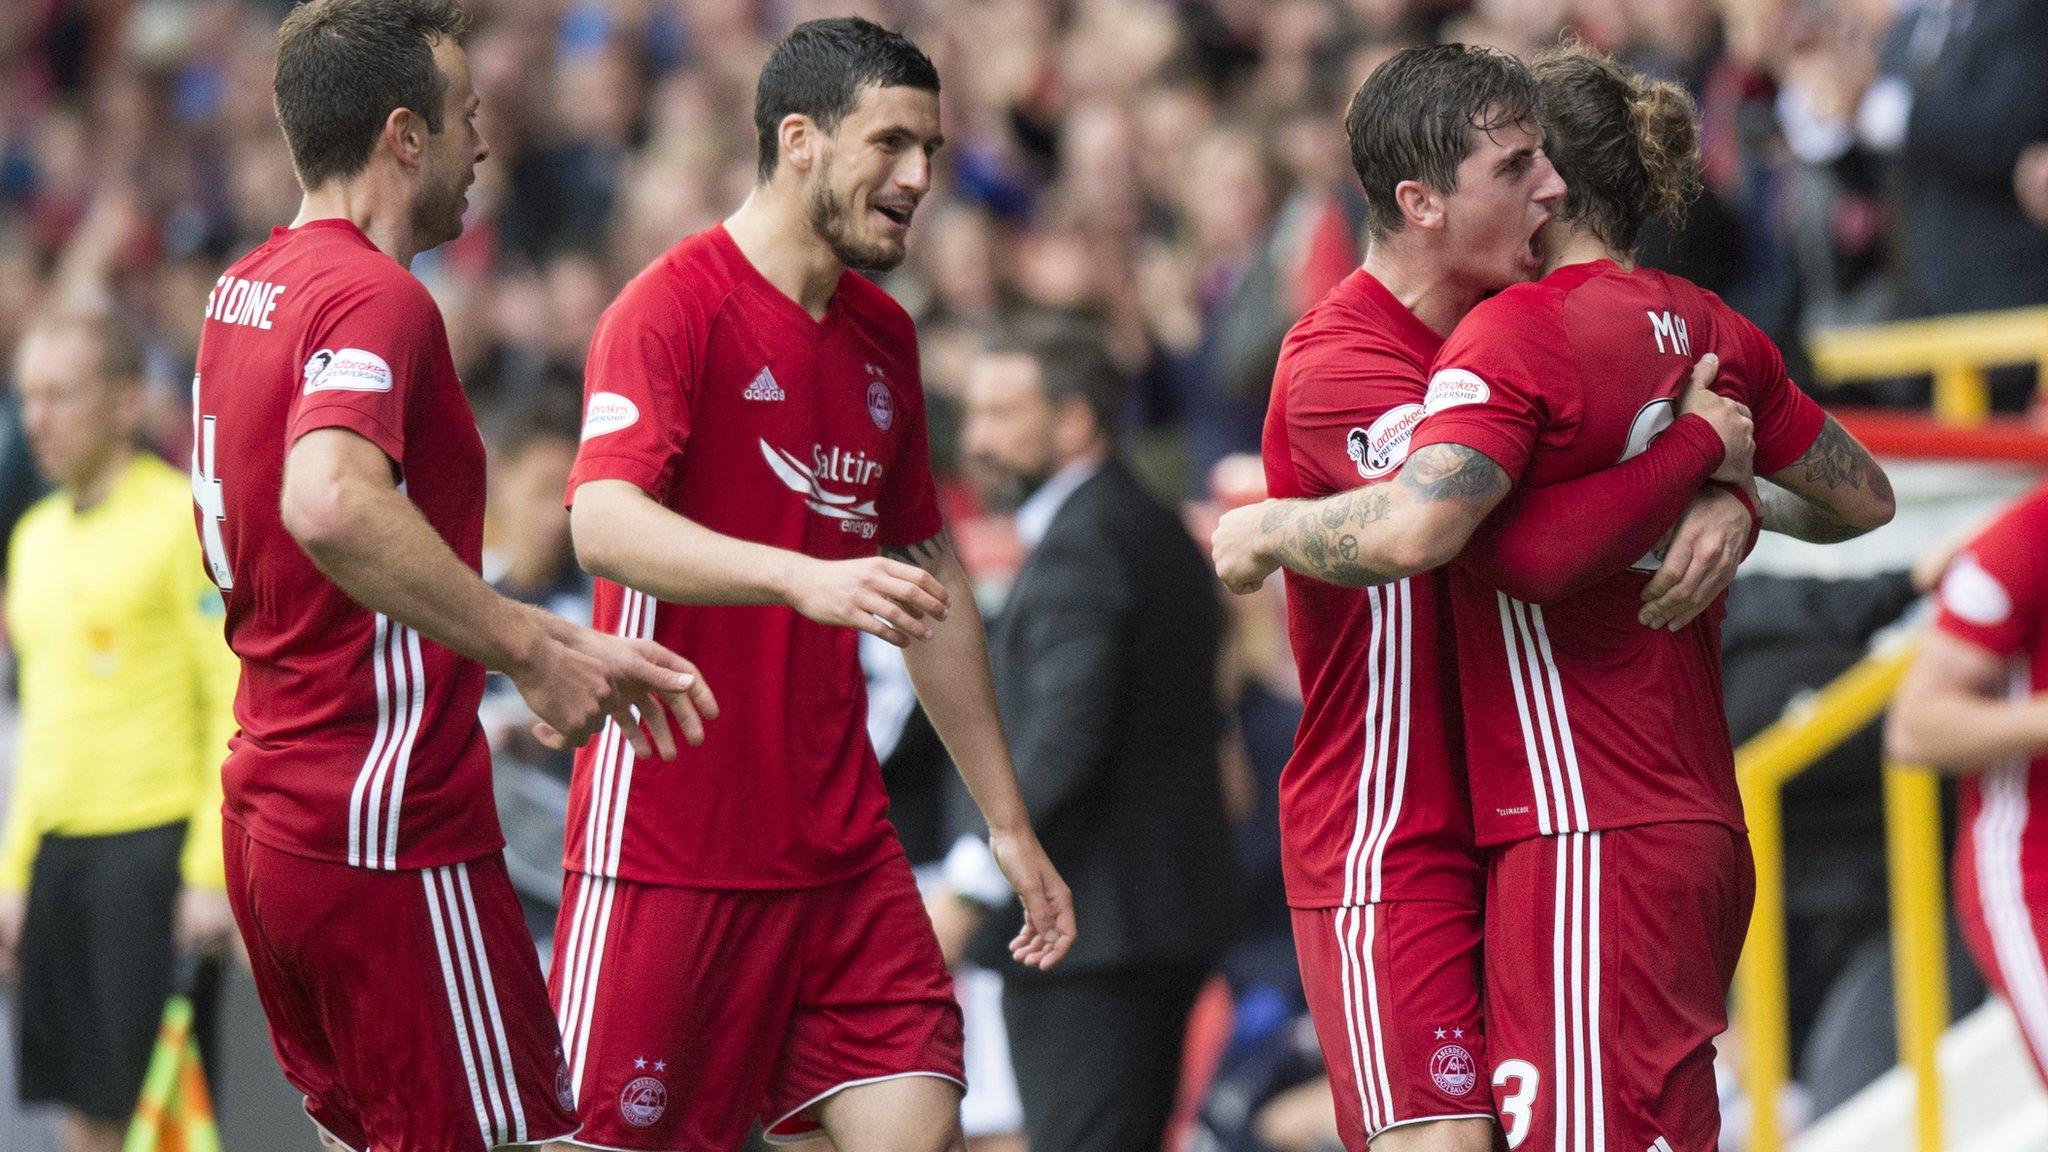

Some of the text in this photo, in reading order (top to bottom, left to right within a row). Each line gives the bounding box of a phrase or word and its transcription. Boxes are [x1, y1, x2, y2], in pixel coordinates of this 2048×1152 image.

[744, 389, 786, 401] adidas
[1371, 408, 1424, 453] Ladbrokes
[841, 518, 878, 539] energy
[1491, 1058, 1541, 1151] 3
